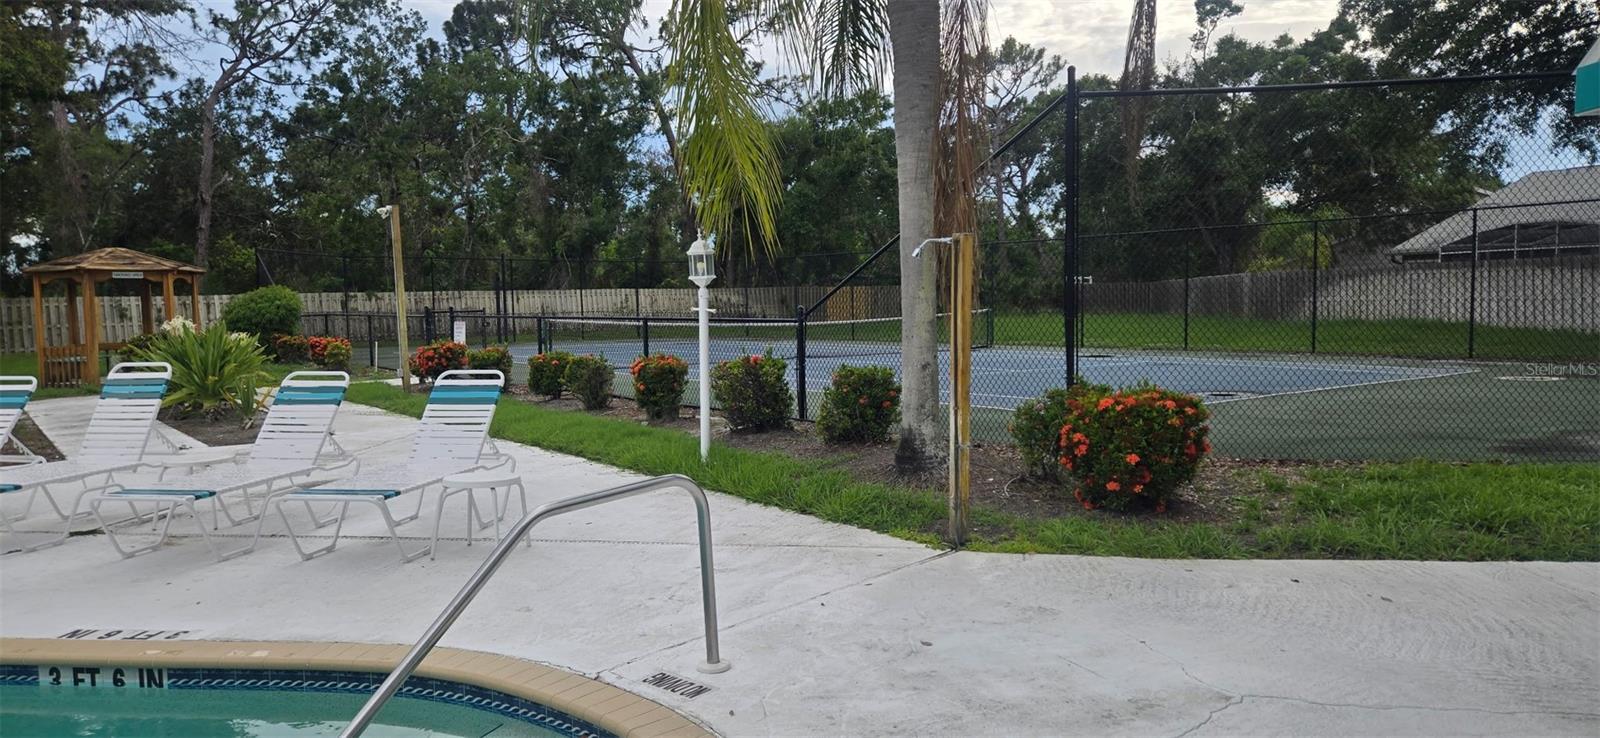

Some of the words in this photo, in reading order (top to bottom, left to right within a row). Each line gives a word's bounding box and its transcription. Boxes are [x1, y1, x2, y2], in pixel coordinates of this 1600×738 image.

[57, 629, 99, 639] IN
[97, 630, 123, 640] 6
[121, 630, 165, 640] FT
[48, 666, 61, 686] 3
[72, 667, 100, 687] FT
[112, 667, 126, 687] 6
[138, 667, 164, 689] IN
[642, 672, 695, 693] DIVING
[679, 685, 712, 699] NO
